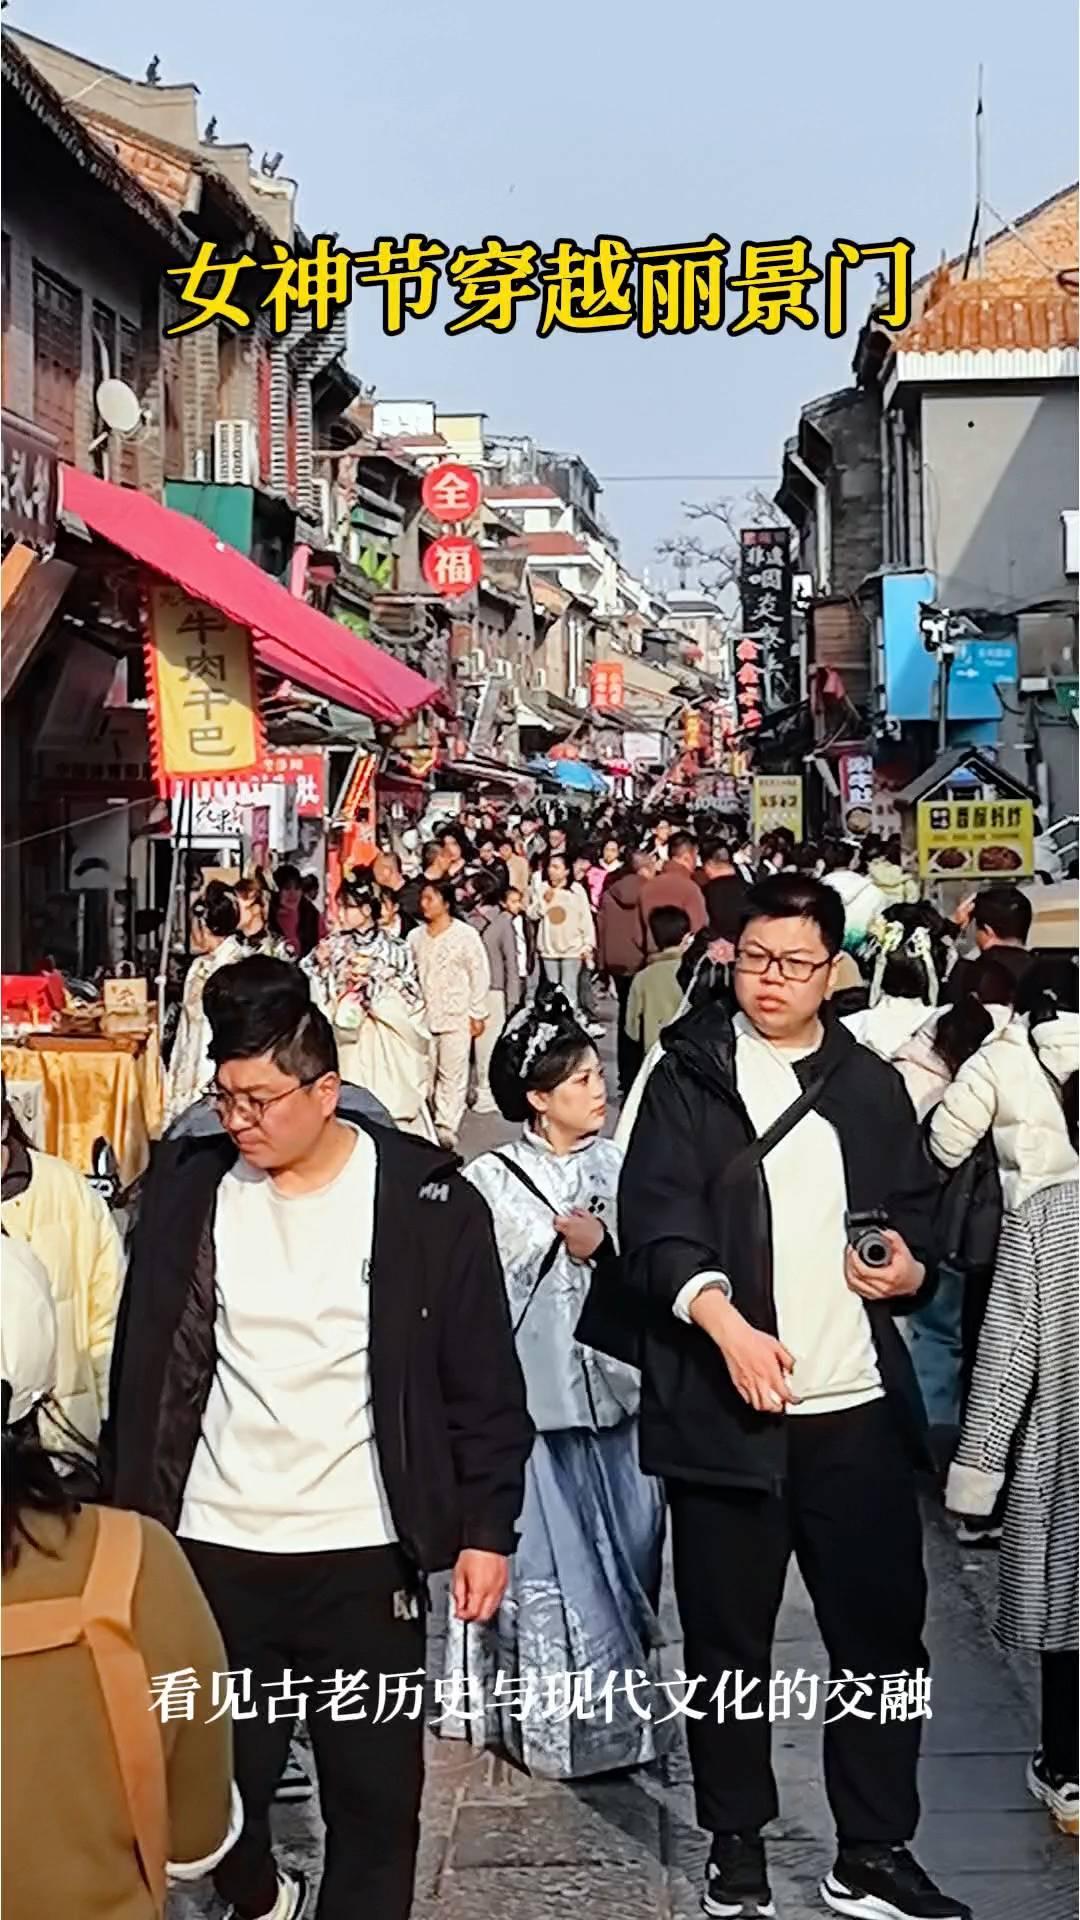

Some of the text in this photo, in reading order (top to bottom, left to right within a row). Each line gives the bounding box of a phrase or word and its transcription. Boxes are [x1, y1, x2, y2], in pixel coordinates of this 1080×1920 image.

[431, 471, 473, 585] 全福
[176, 610, 236, 757] 牛肉干巴
